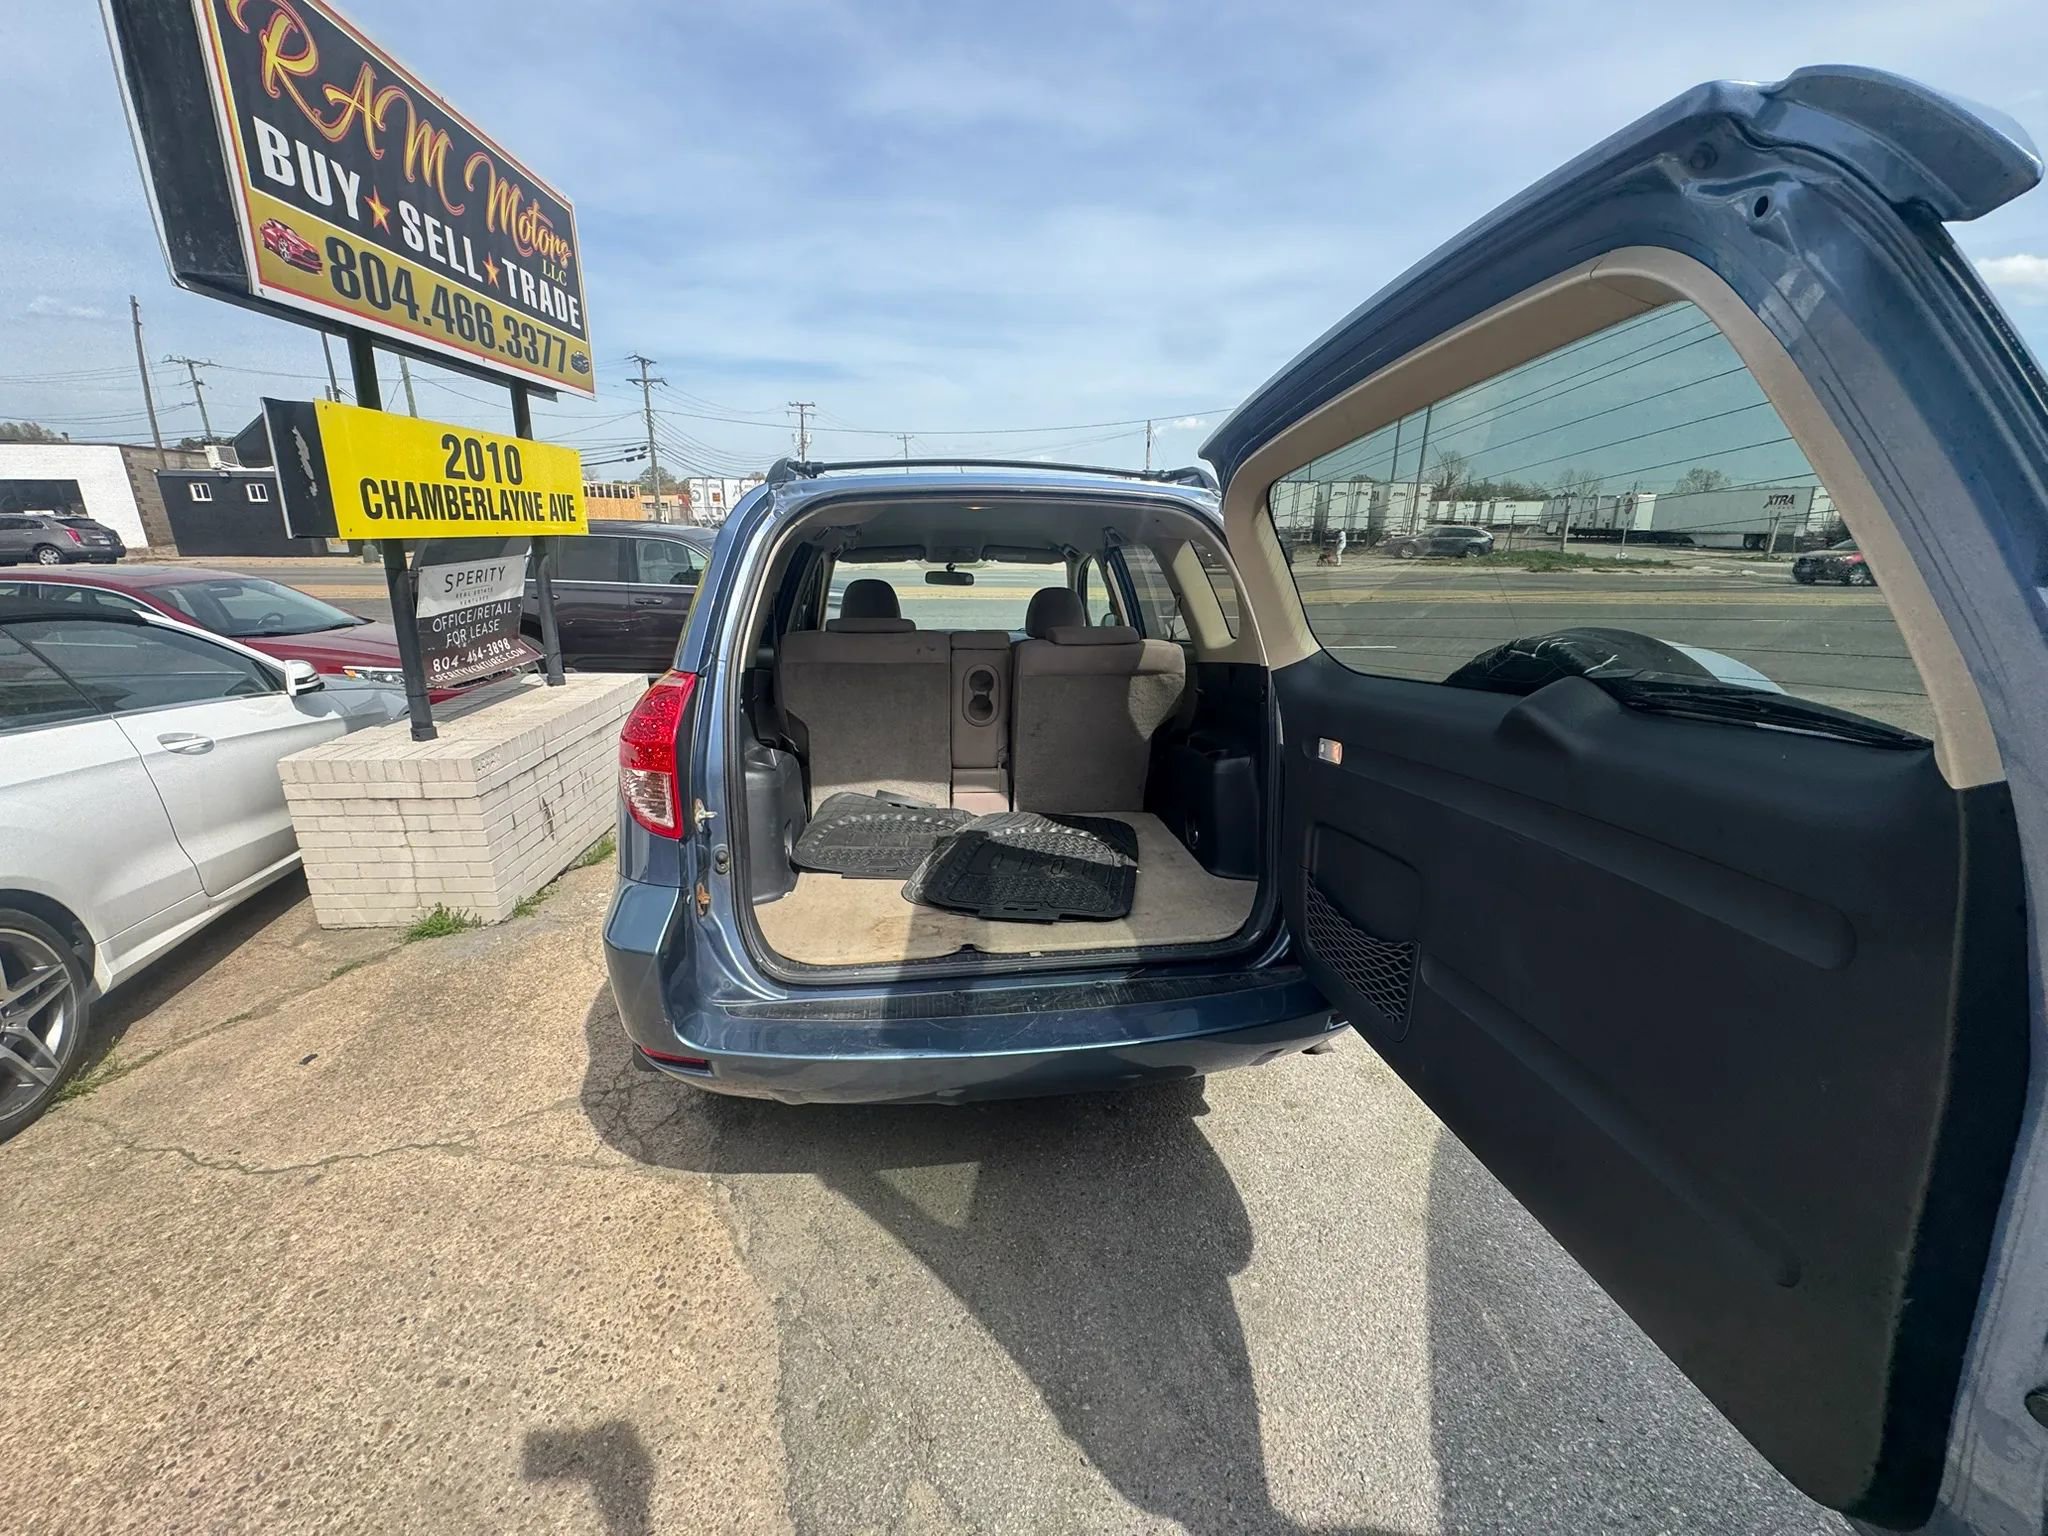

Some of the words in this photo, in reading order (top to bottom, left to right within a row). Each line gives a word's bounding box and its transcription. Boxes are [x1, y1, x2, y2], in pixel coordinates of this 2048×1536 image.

[252, 116, 361, 221] BUY
[398, 200, 484, 283] SELL
[501, 257, 581, 330] TRADE
[464, 152, 572, 269] Motors
[542, 258, 568, 287] LLC
[325, 236, 567, 374] 804.466.3377
[441, 433, 523, 486] 2010
[360, 477, 545, 522] CHAMBERLAYNE
[549, 493, 577, 522] AVE
[1763, 494, 1796, 509] XTRA
[444, 565, 506, 593] SPERITY
[432, 601, 513, 633] OFFICE/RETAIL
[445, 629, 467, 649] FOR
[469, 618, 501, 639] LEASE
